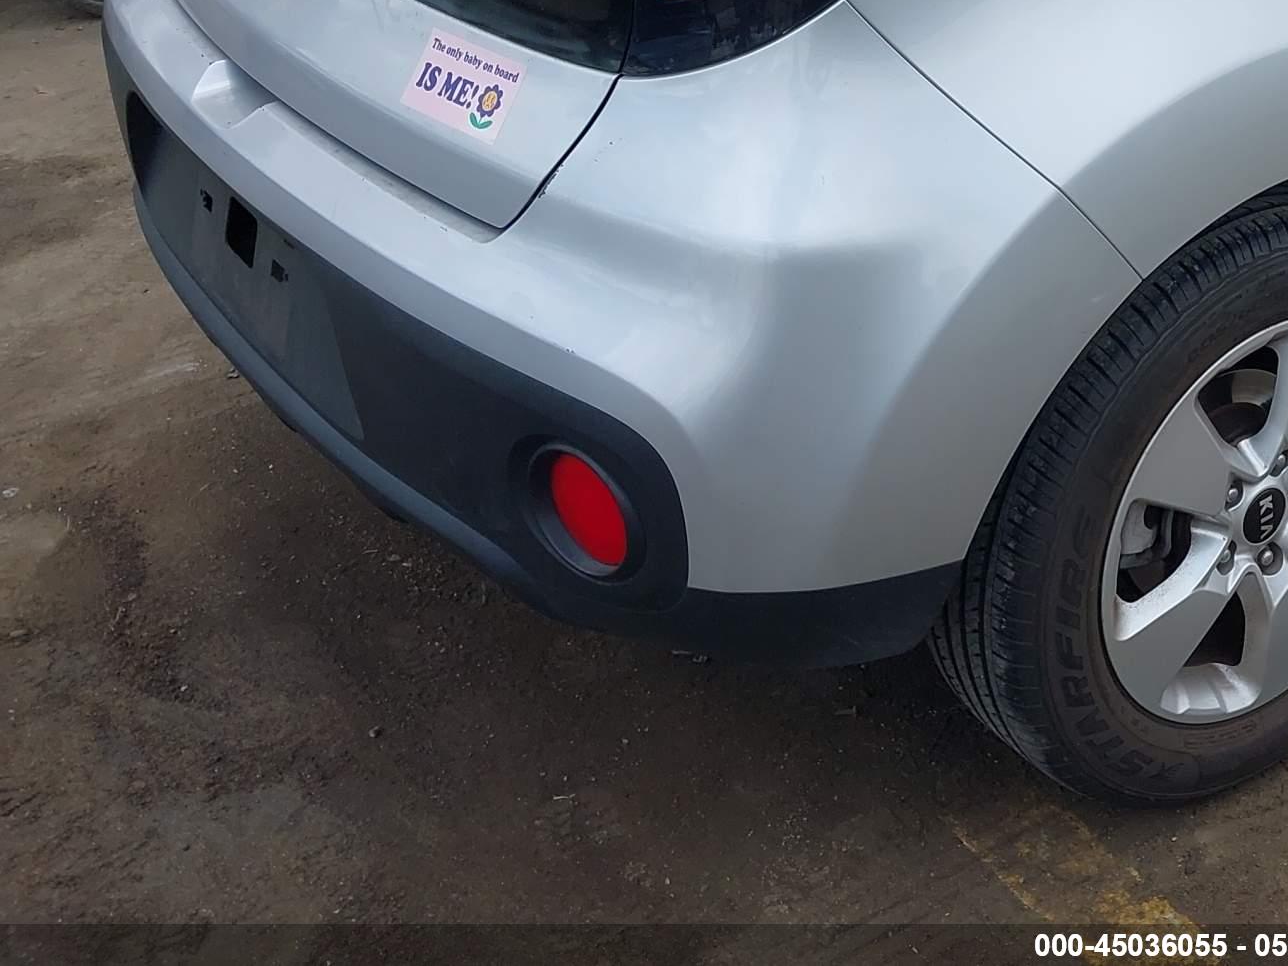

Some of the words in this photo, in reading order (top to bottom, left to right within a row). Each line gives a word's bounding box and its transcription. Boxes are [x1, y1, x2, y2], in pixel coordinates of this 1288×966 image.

[432, 38, 446, 52] The
[447, 47, 463, 61] only
[464, 52, 482, 69] baby
[483, 62, 493, 73] on
[495, 65, 519, 83] board
[416, 63, 442, 91] IS
[438, 72, 479, 109] ME!
[1259, 494, 1274, 540] KIA
